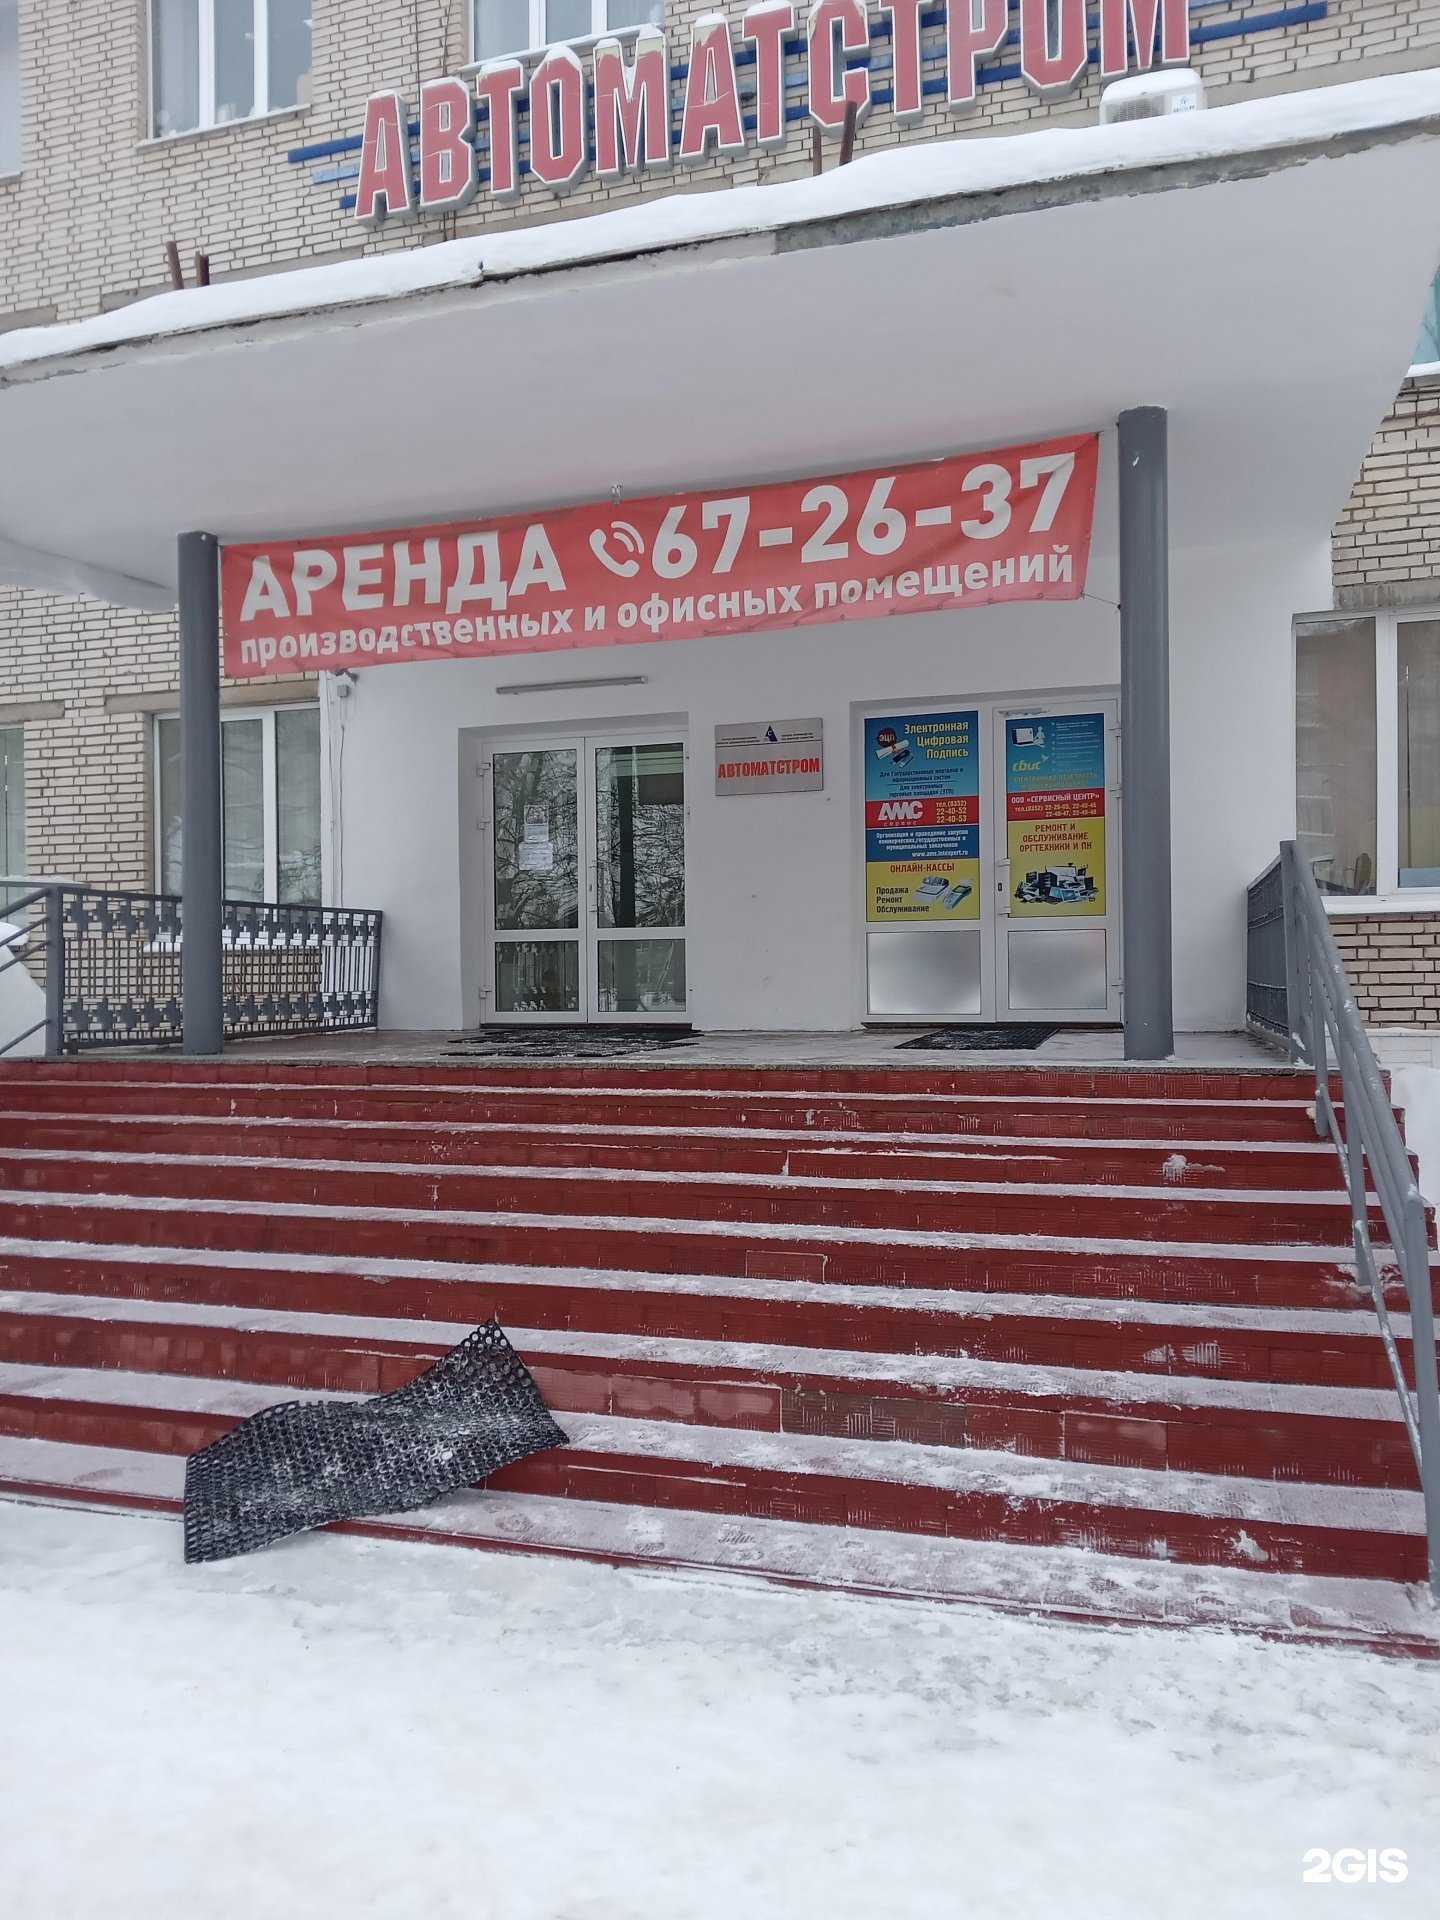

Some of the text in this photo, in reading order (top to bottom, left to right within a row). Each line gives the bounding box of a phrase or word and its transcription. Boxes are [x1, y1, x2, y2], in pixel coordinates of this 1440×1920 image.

[355, 0, 1190, 220] АВТОМАТСТРОМ
[240, 452, 1075, 622] АРЕНДА 67-26-37
[240, 544, 1073, 667] производственных и офисных помещений
[904, 722, 969, 734] Электронная
[916, 735, 969, 748] Цифровая
[926, 748, 969, 760] Подпись
[717, 757, 820, 779] АВТОМАТСТРОМ
[1035, 823, 1076, 832] РЕМОНТ И
[1022, 832, 1089, 843] ОБСЛУЖИВАНИЕ
[1019, 843, 1070, 852] ОРГТЕХНИКИ
[876, 886, 909, 895] Продажа
[876, 896, 902, 904] Ремонт
[876, 905, 930, 914] Обслуживание
